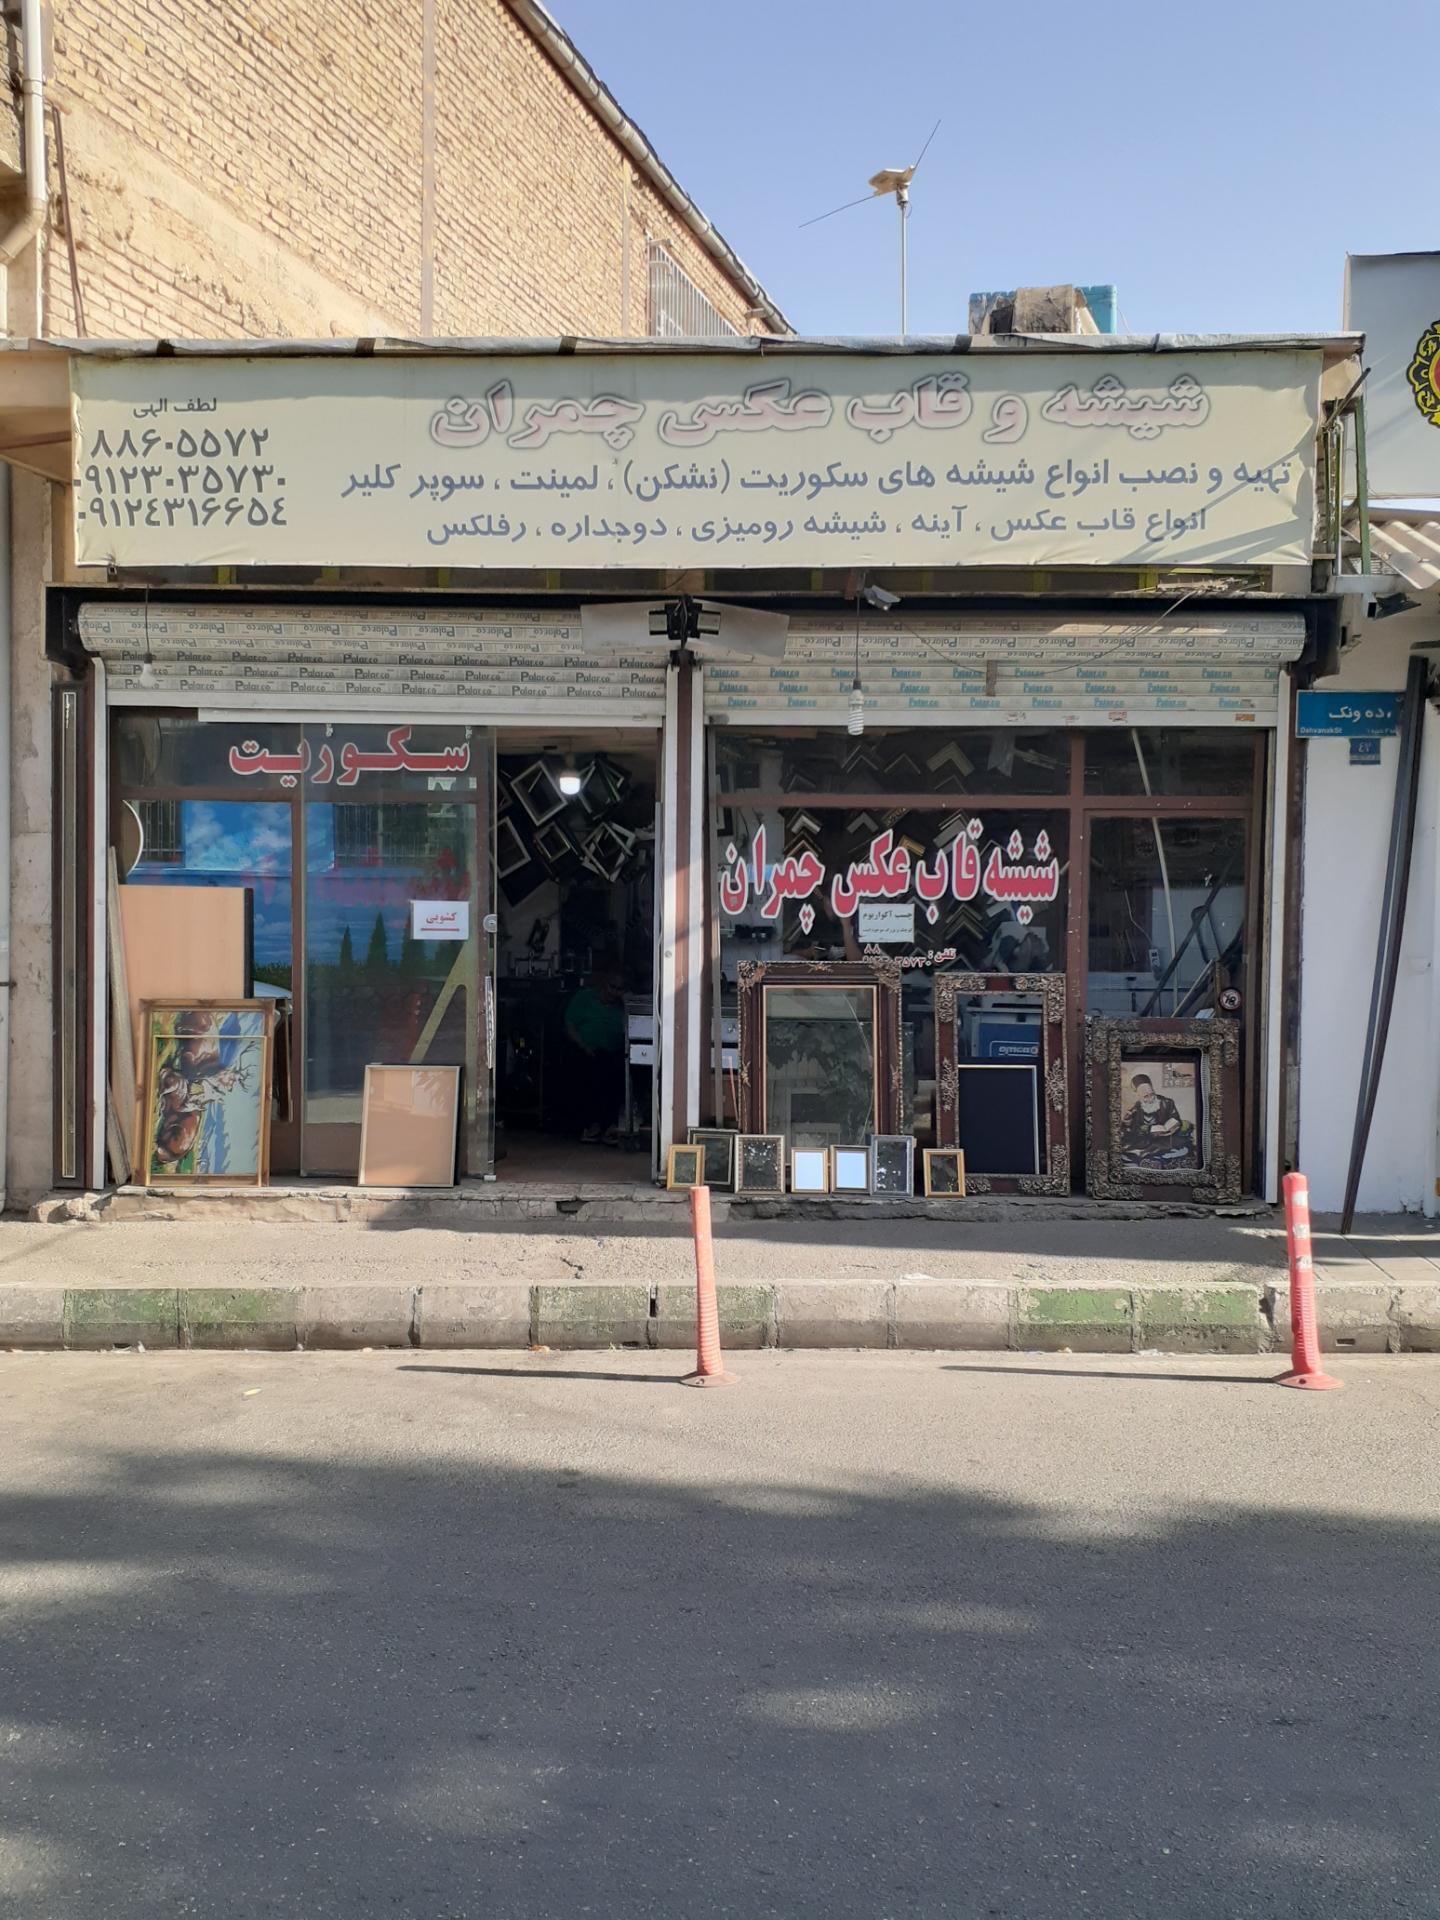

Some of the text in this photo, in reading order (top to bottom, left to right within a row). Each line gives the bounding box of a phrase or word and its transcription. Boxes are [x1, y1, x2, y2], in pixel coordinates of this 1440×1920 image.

[133, 398, 217, 418] لطف الهی
[429, 371, 1210, 450] شیشه و قاب عکس چمران
[90, 428, 269, 458] ۸۸۶۰۵۵۷۲
[74, 464, 286, 494] ۰۹۱۲۳۰۳۵۷۳۰
[340, 463, 401, 499] کلیر
[409, 470, 485, 501] سوپر
[510, 465, 598, 498] لمینت
[623, 459, 731, 501] (نشکن)
[740, 461, 868, 501] سکوریت
[878, 460, 936, 495] های
[946, 458, 1035, 494] شیشه
[1044, 459, 1109, 499] انواع
[1119, 462, 1198, 492] نصب
[1207, 466, 1223, 494] و
[1233, 462, 1291, 494] تهیه
[427, 514, 526, 545] رفلکس
[551, 515, 667, 544] دوجداره
[691, 517, 794, 544] رومیزی
[803, 511, 887, 541] شیشه
[911, 505, 967, 539] آینه
[990, 509, 1067, 541] عکس
[1076, 508, 1136, 537] قاب
[1145, 508, 1206, 542] انواع
[1329, 706, 1360, 722] ونک
[1365, 708, 1384, 718] ده
[229, 725, 470, 788] سکوریت
[721, 818, 1059, 935] شیشه قاب عکس چمران
